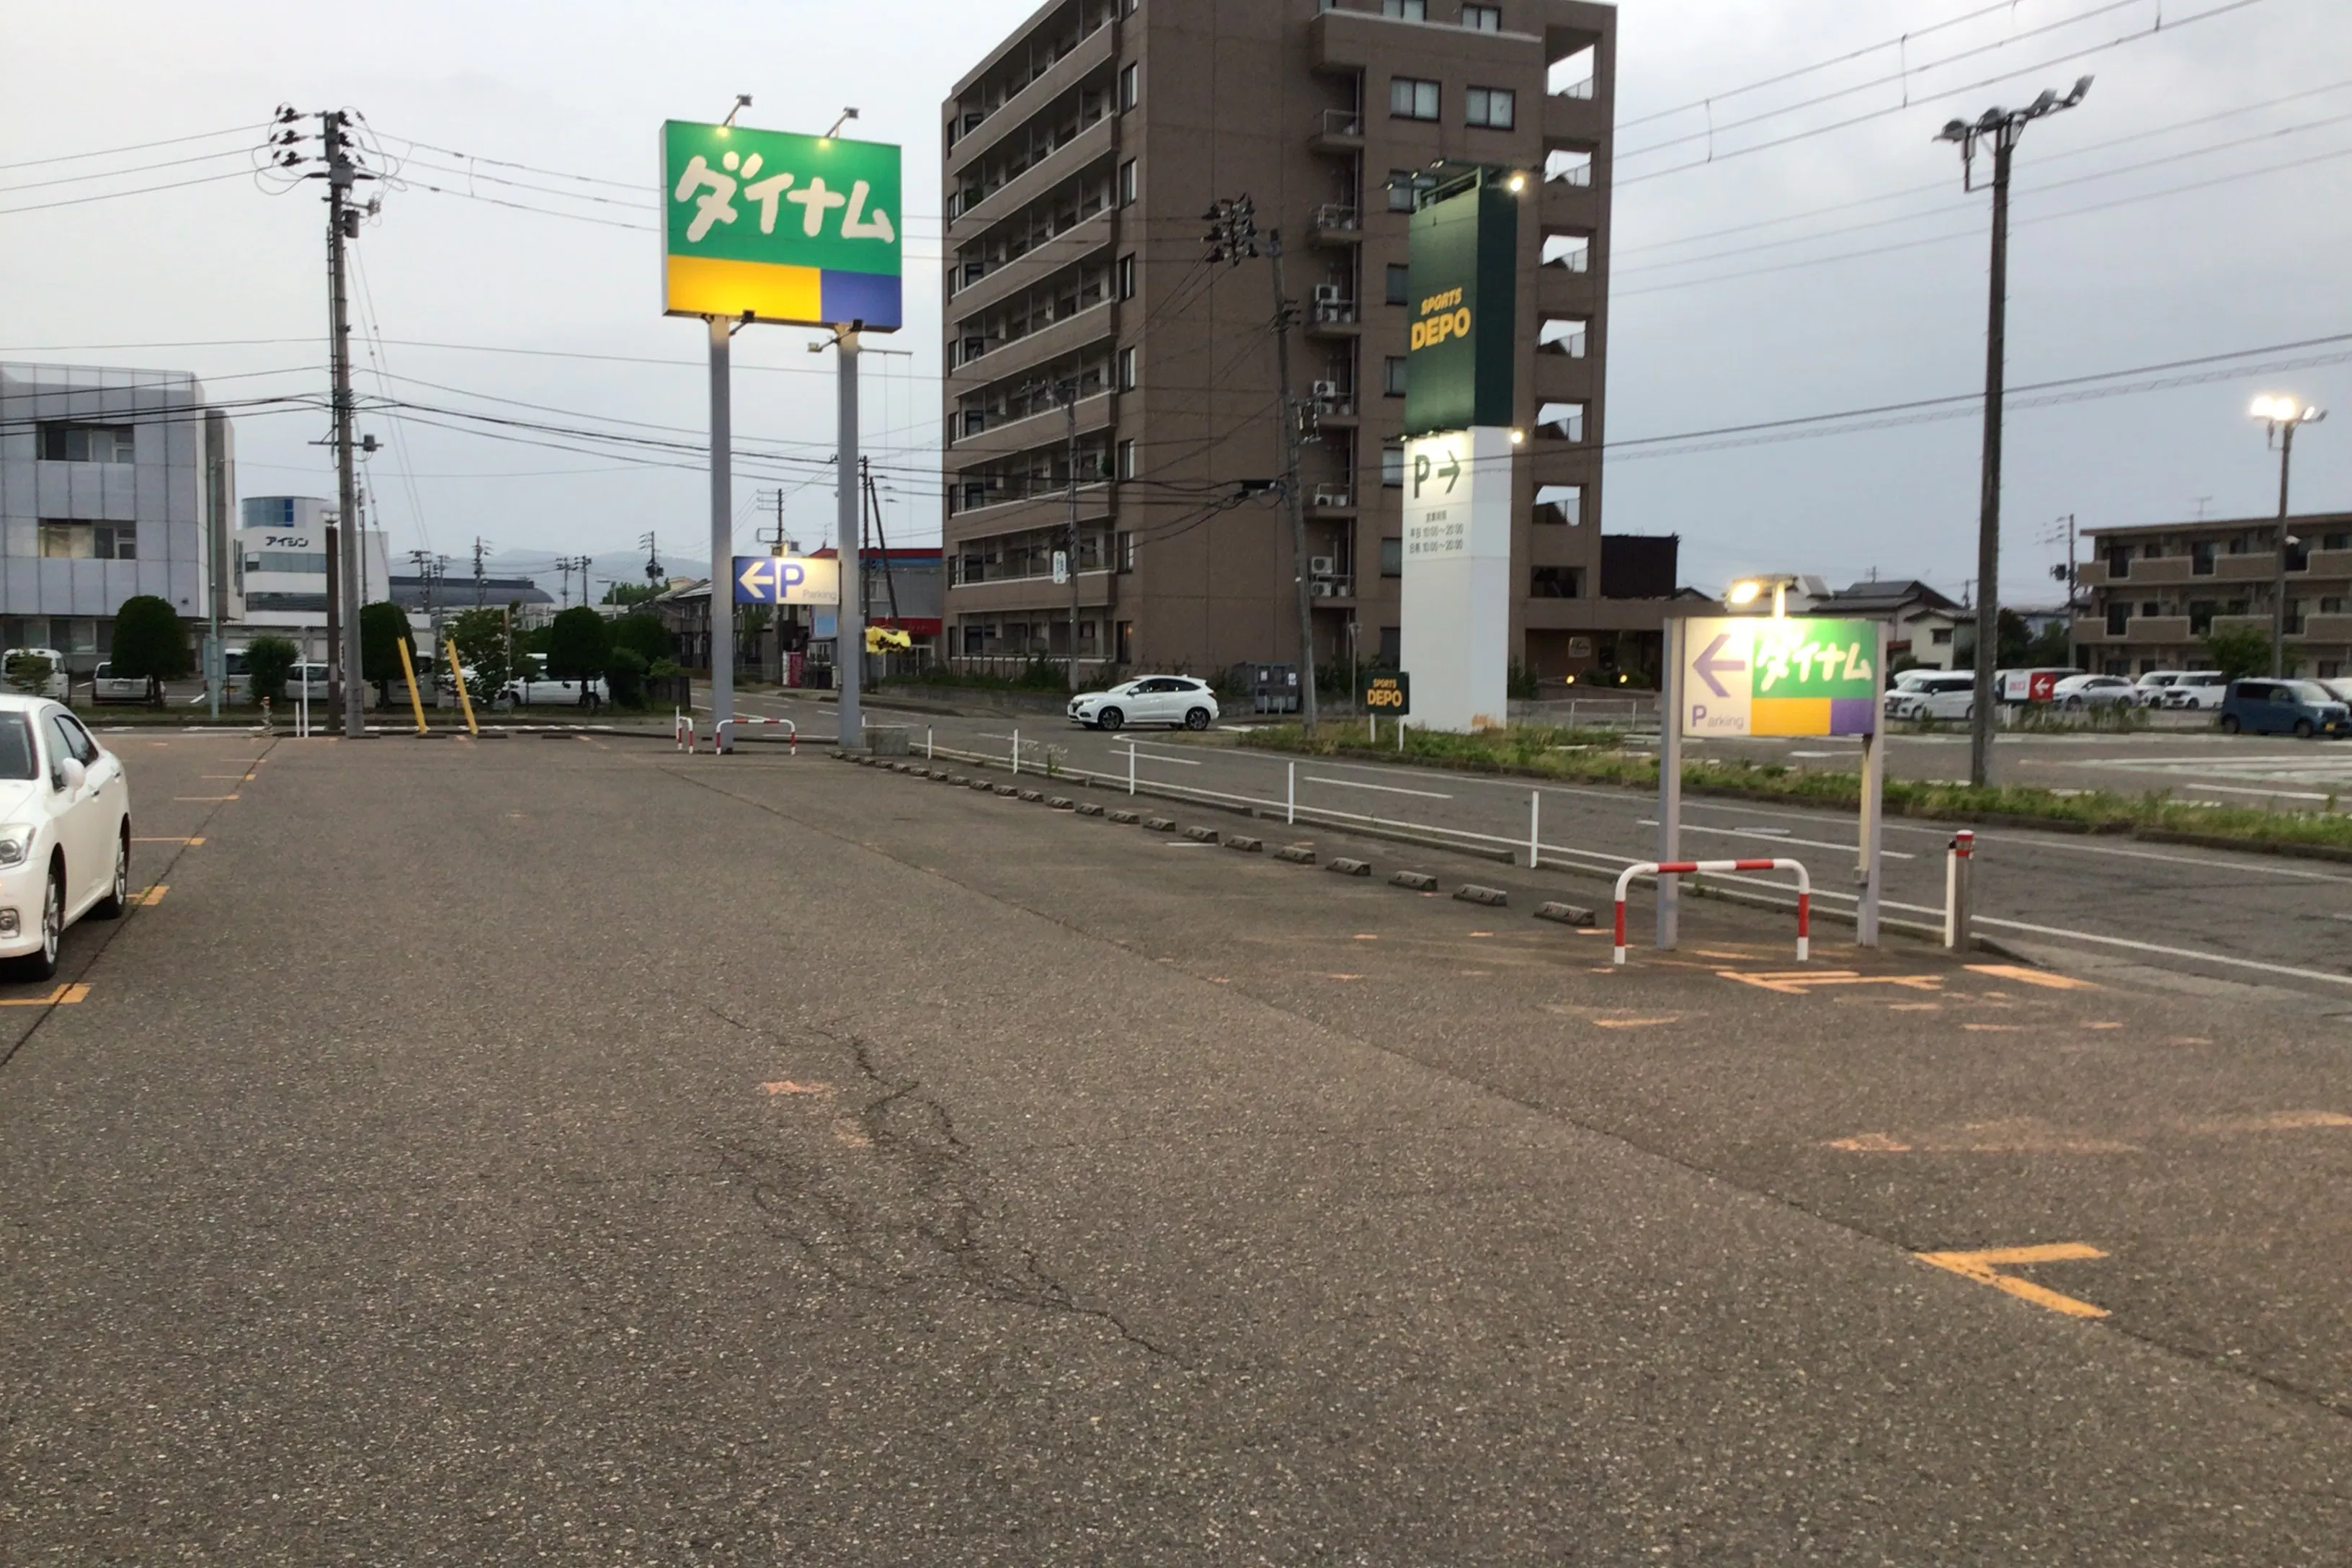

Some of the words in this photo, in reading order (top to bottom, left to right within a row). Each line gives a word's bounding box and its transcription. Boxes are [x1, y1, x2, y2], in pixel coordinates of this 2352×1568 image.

[674, 151, 895, 244] ダイナム
[1421, 287, 1462, 316] SPORTS
[1411, 307, 1471, 352] DEPO
[1414, 454, 1430, 499] P
[265, 535, 308, 548] アイシン
[780, 564, 805, 598] P
[803, 588, 838, 602] Parking
[1755, 627, 1872, 692] ダイナム
[1367, 689, 1402, 707] DEPO
[1691, 704, 1744, 730] Parking
